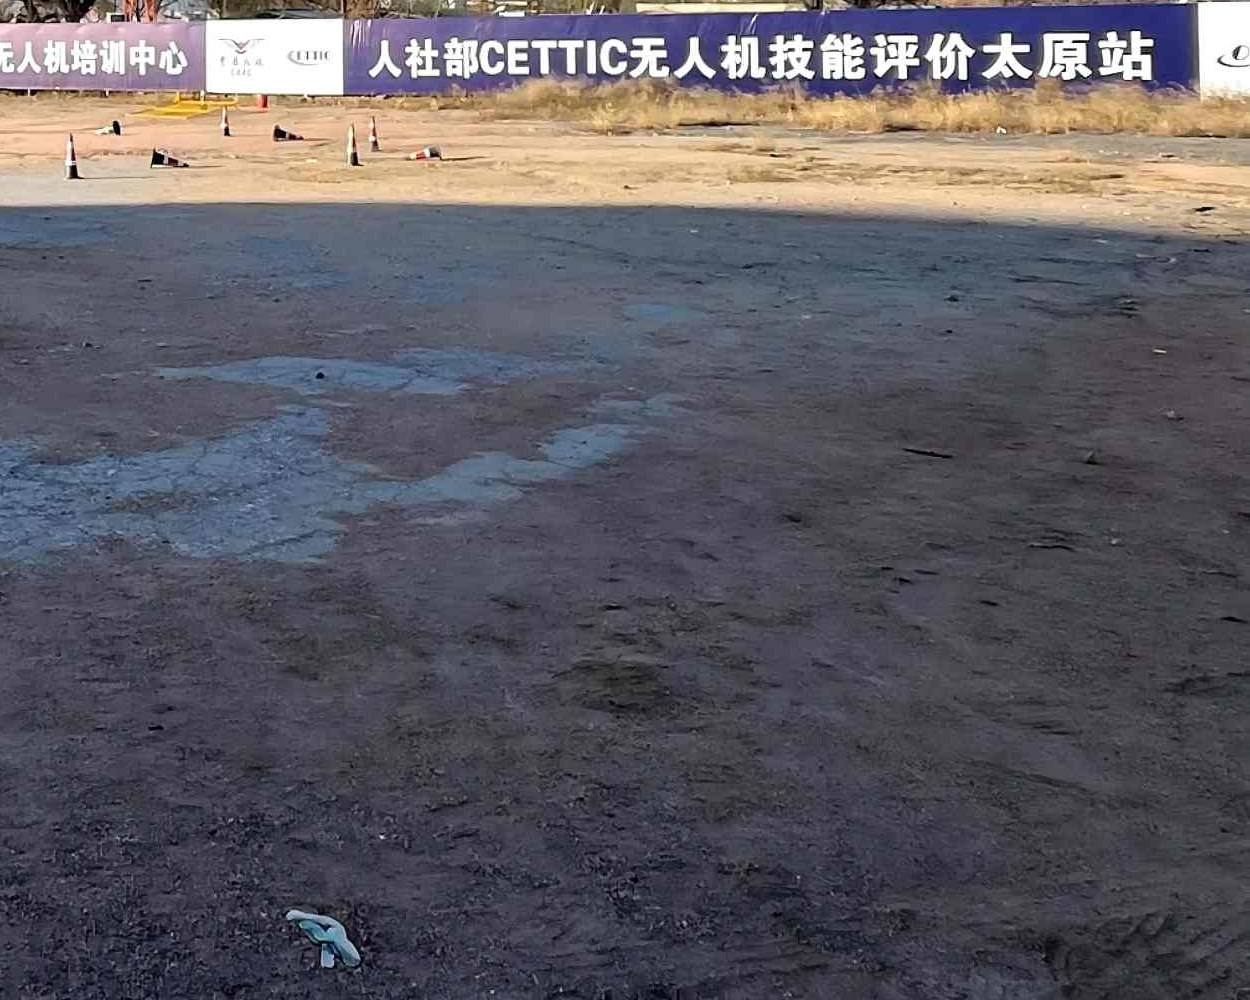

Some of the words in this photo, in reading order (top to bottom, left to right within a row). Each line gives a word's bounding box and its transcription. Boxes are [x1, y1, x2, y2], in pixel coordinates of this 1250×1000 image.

[369, 31, 1154, 81] 人社部CETTIC无人机技能评价太原站
